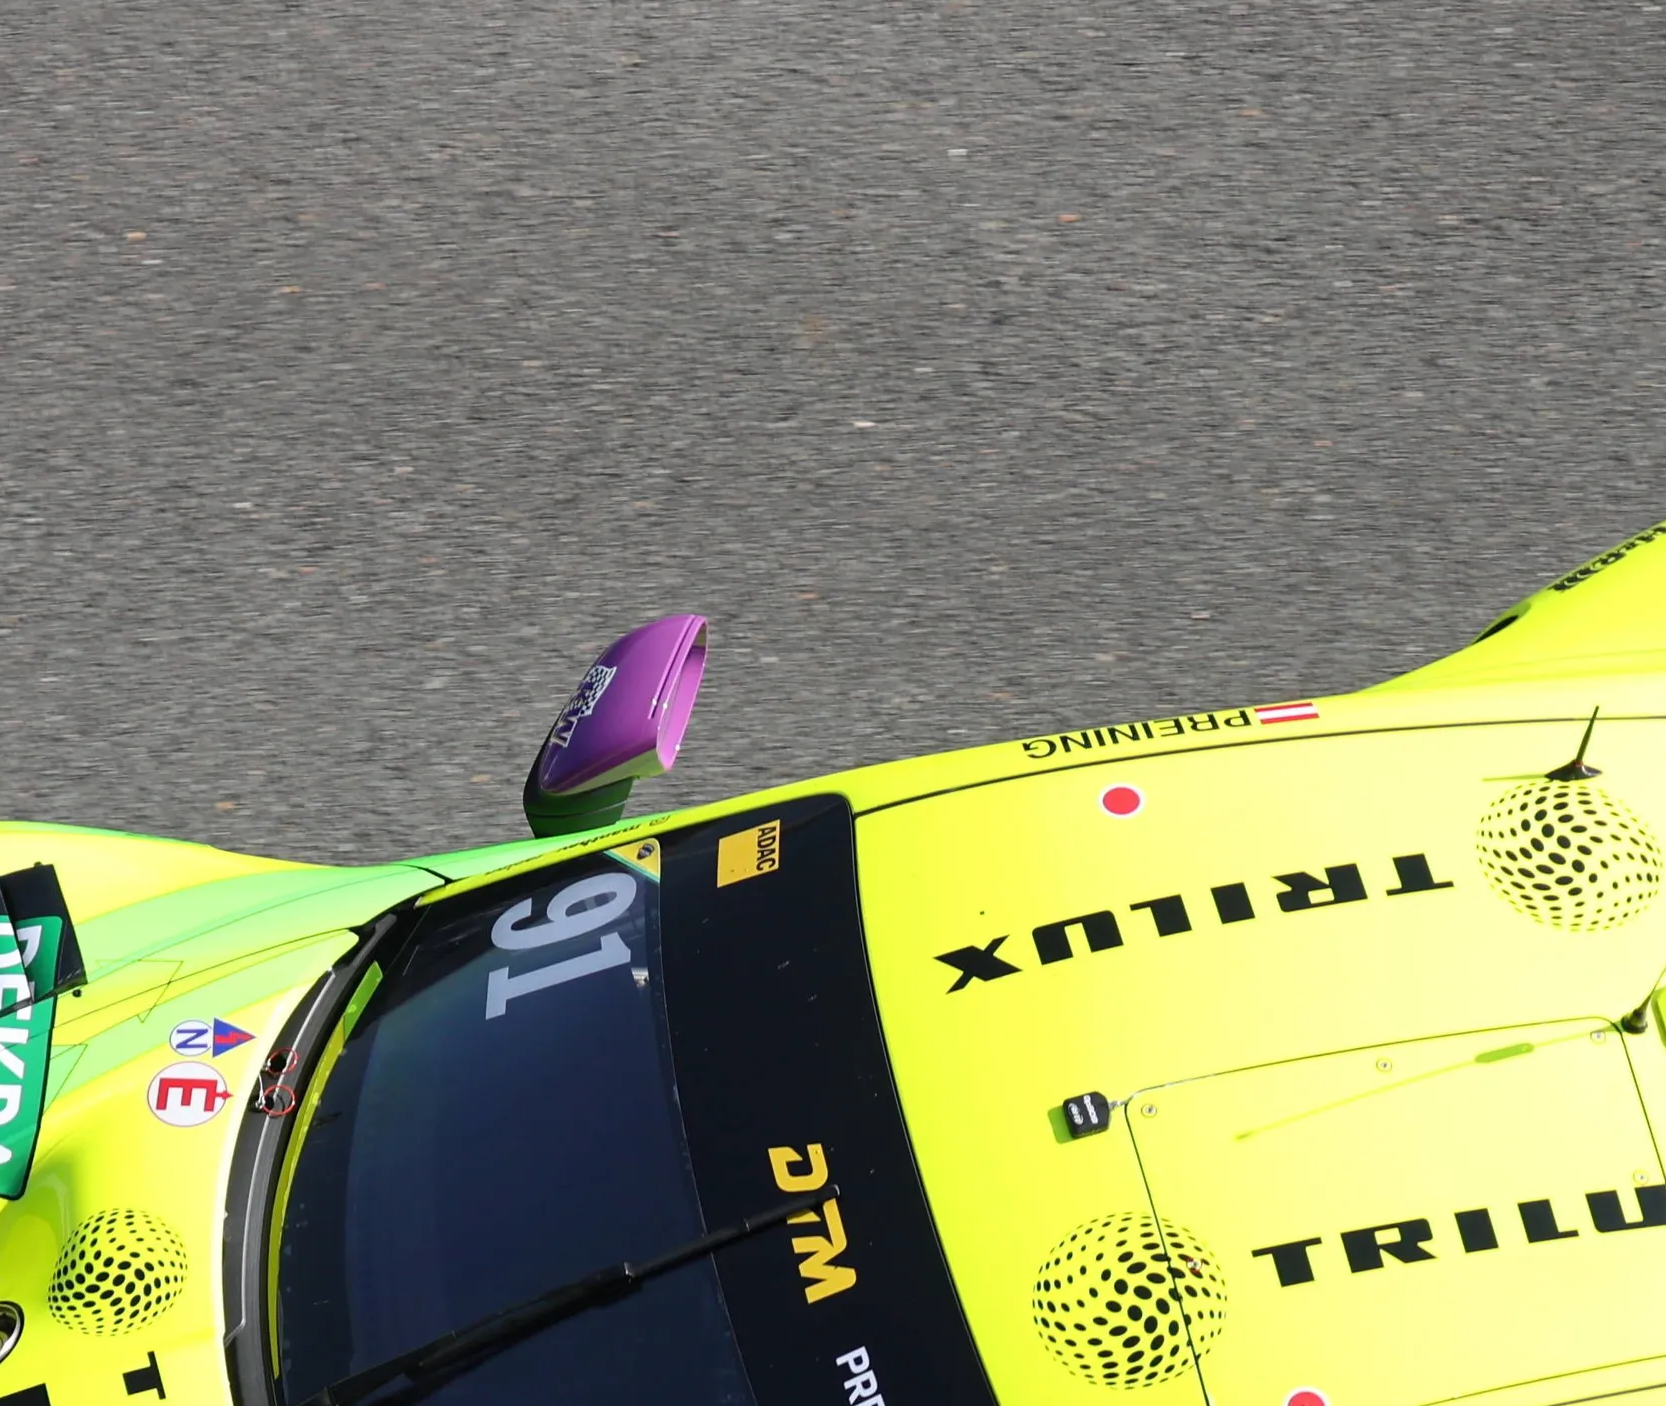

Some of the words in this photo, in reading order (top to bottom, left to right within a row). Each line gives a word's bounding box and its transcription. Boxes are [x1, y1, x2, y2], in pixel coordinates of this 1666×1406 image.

[1022, 709, 1253, 760] PREINING
[756, 825, 779, 872] ADAC
[485, 872, 637, 1020] 91
[933, 853, 1455, 995] TRILUX
[768, 1143, 857, 1303] DTM
